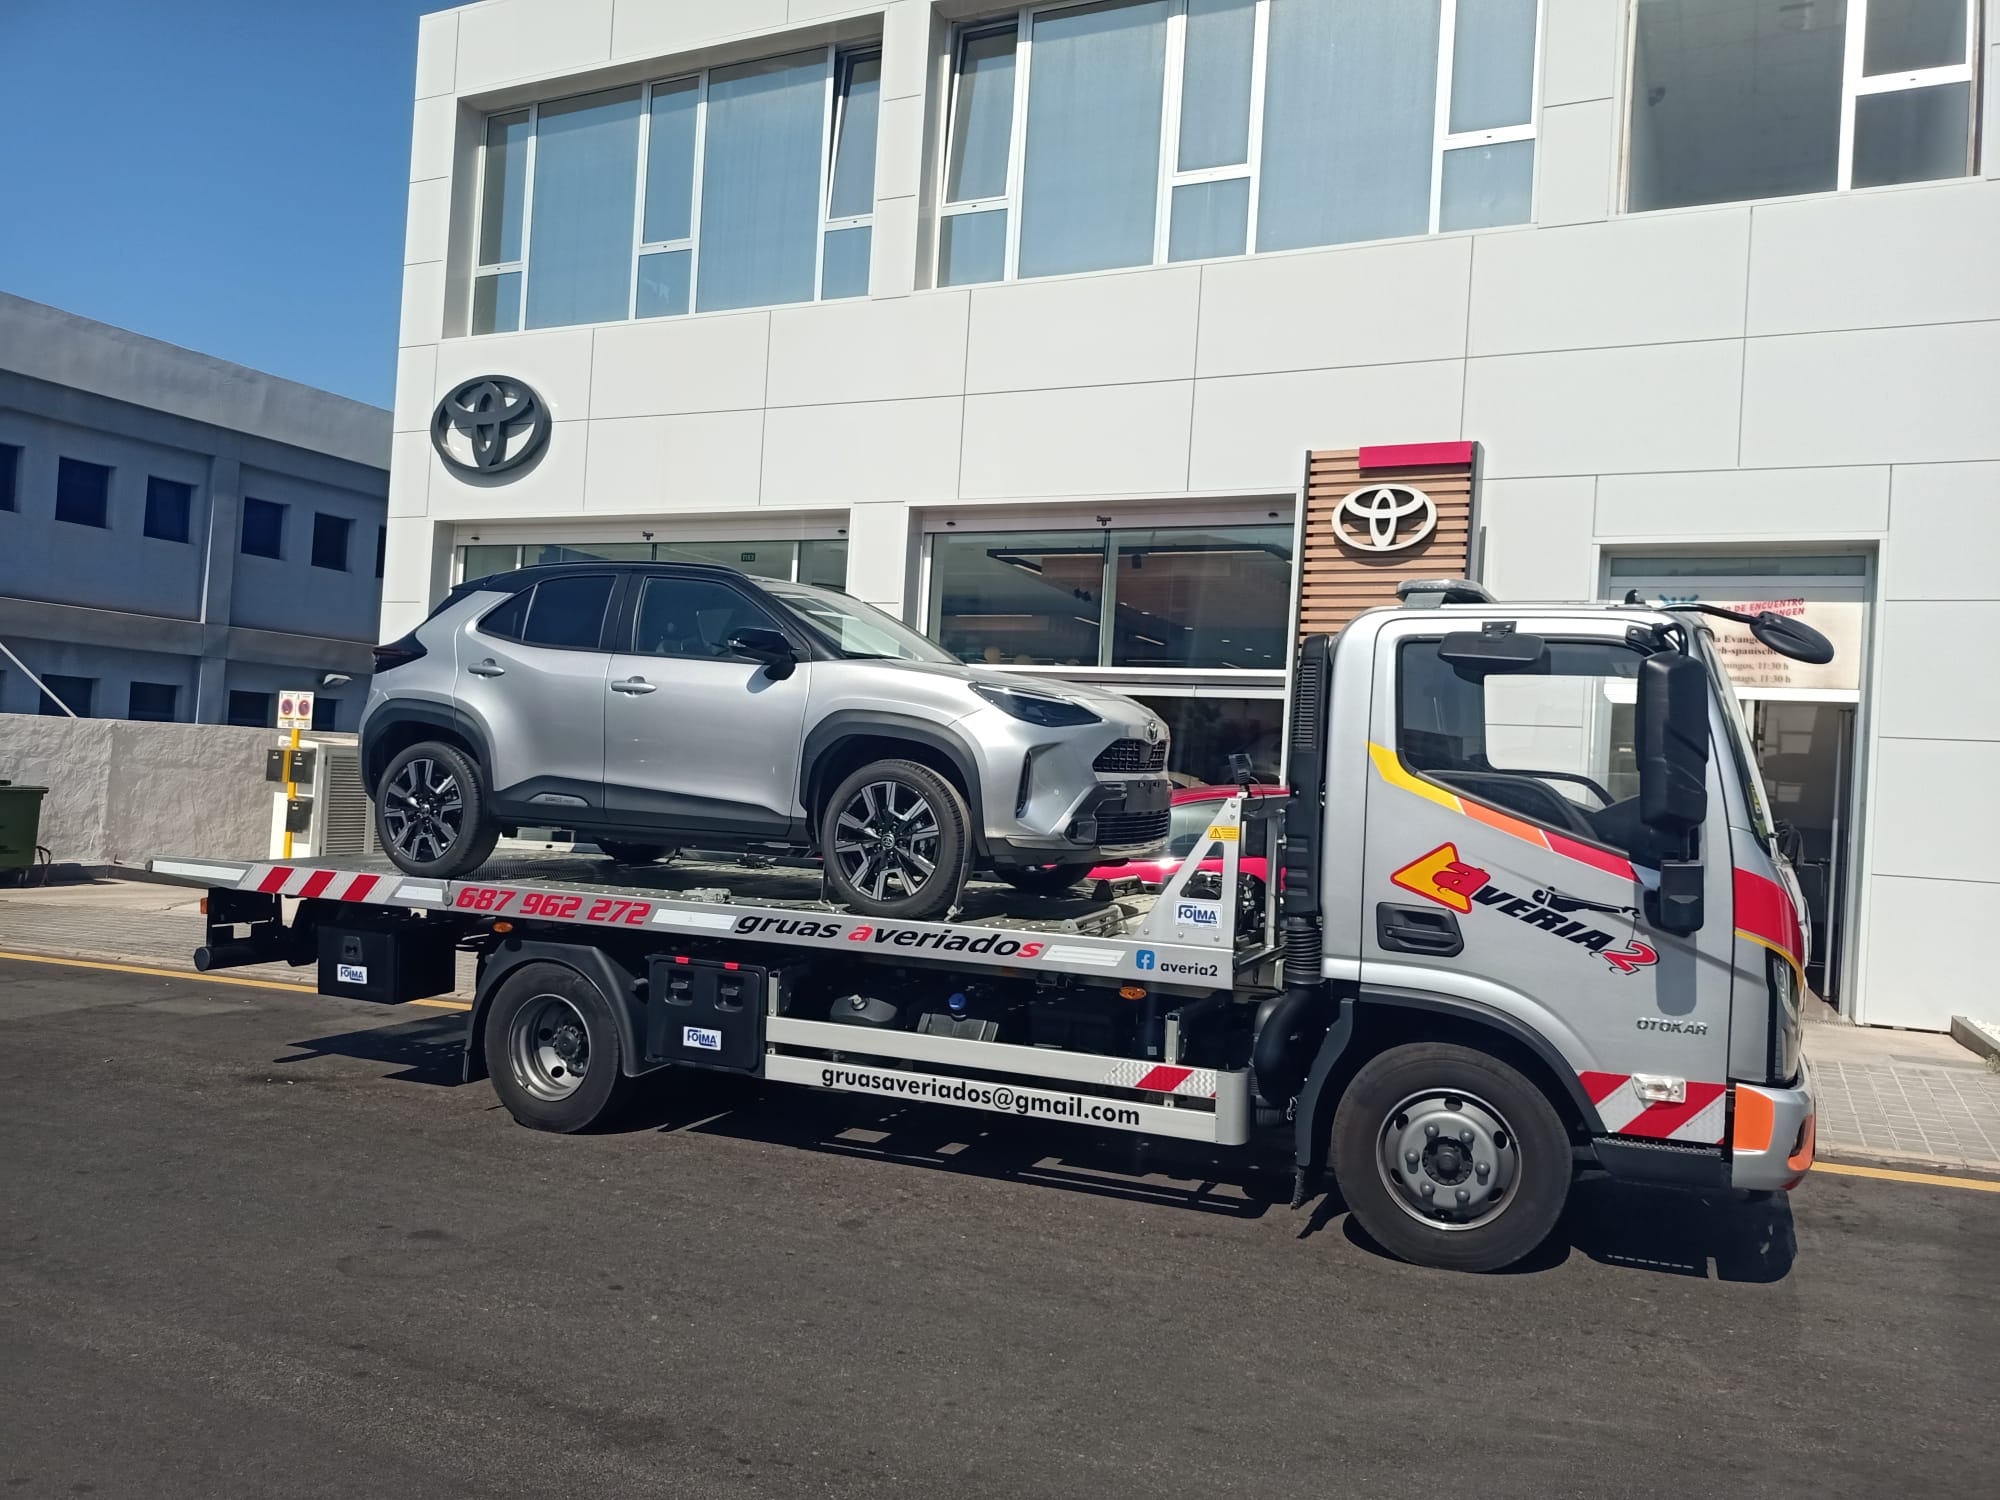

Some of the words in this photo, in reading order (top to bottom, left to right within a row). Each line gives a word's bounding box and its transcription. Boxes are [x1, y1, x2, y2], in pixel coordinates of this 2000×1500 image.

[1750, 598, 1805, 611] ENCUENTRO
[456, 887, 517, 912] 687
[519, 892, 583, 919] 962
[587, 898, 652, 925] 272
[734, 912, 842, 939] gruas
[847, 922, 1045, 959] averiados
[1160, 961, 1218, 977] averia2
[1636, 1017, 1709, 1036] OTOKAR
[821, 1066, 1140, 1126] gruasaveriados@gmail.com
